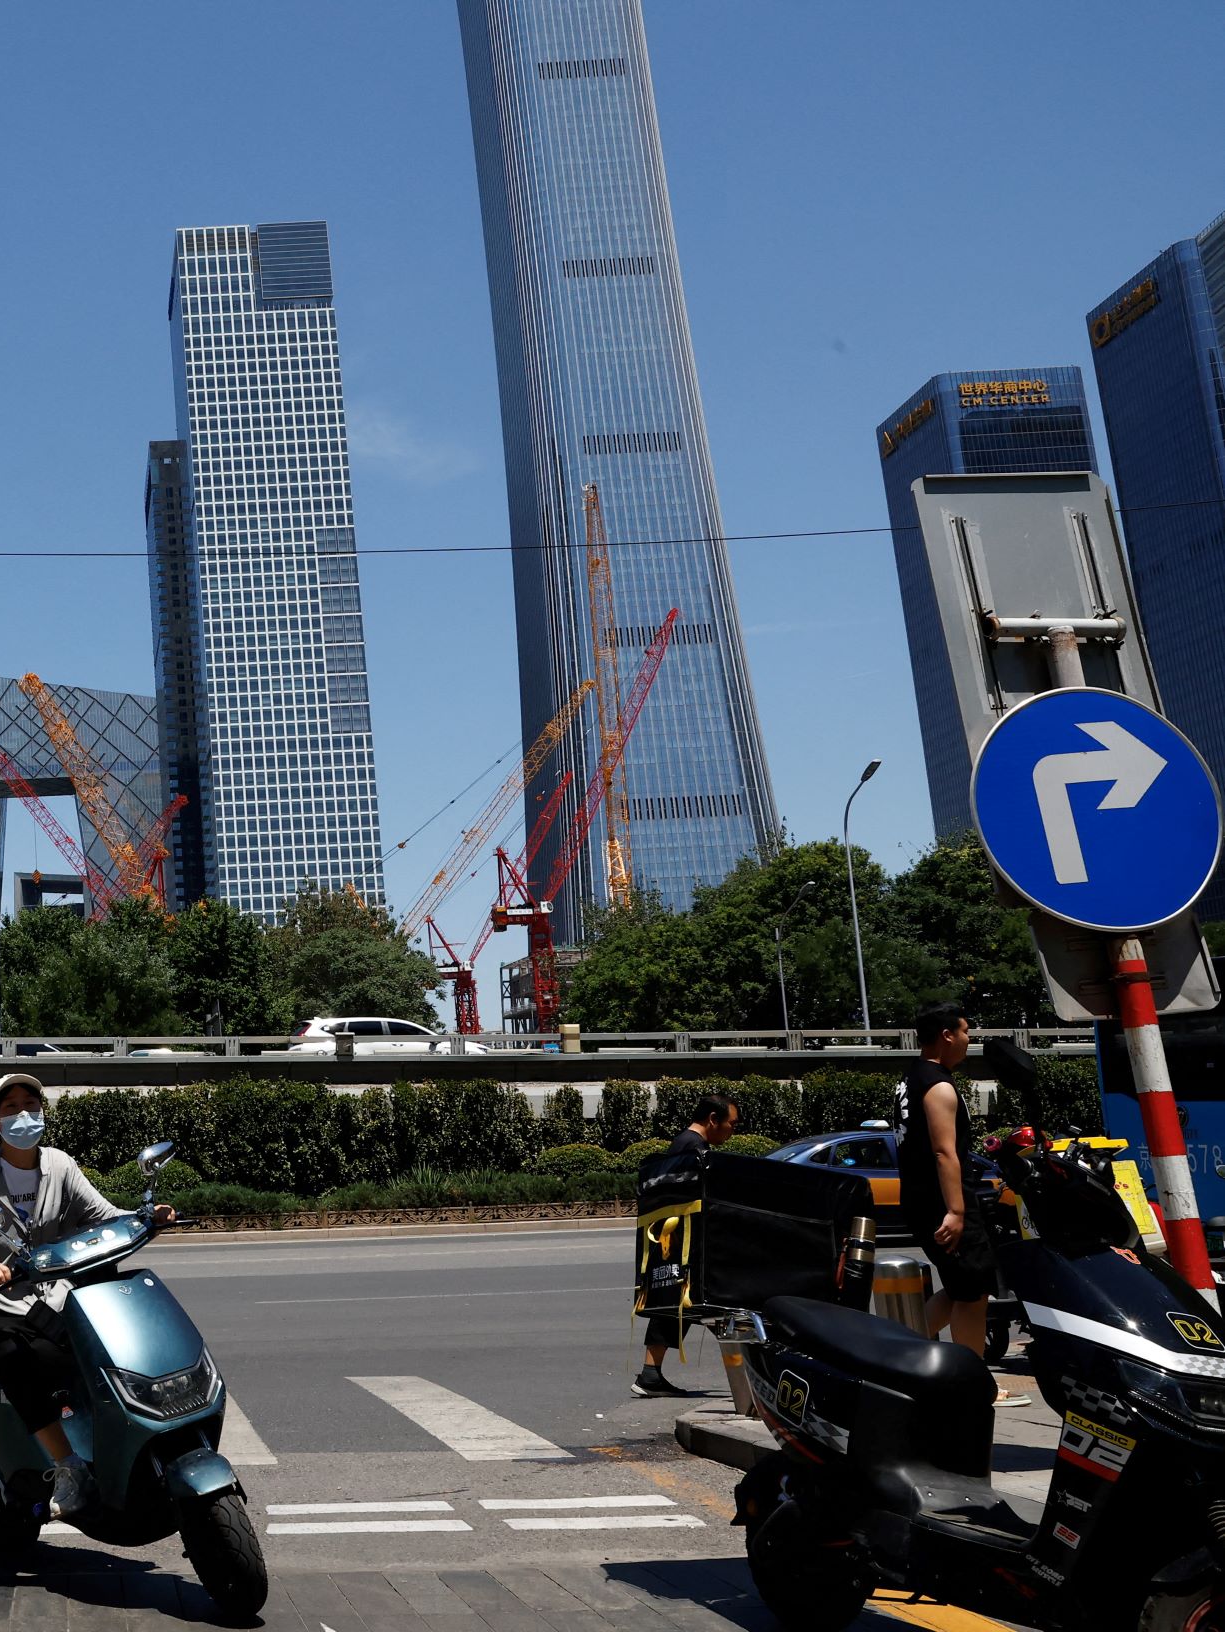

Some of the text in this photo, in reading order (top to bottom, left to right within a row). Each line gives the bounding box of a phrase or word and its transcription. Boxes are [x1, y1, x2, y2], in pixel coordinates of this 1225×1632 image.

[959, 380, 1047, 395] 世界华商中心
[962, 395, 1050, 406] CM CENTER
[653, 1264, 680, 1280] 美团外卖
[1175, 1320, 1220, 1344] 02
[779, 1380, 805, 1417] 02
[1070, 1415, 1129, 1446] CLASSIC
[1061, 1423, 1132, 1473] 02
